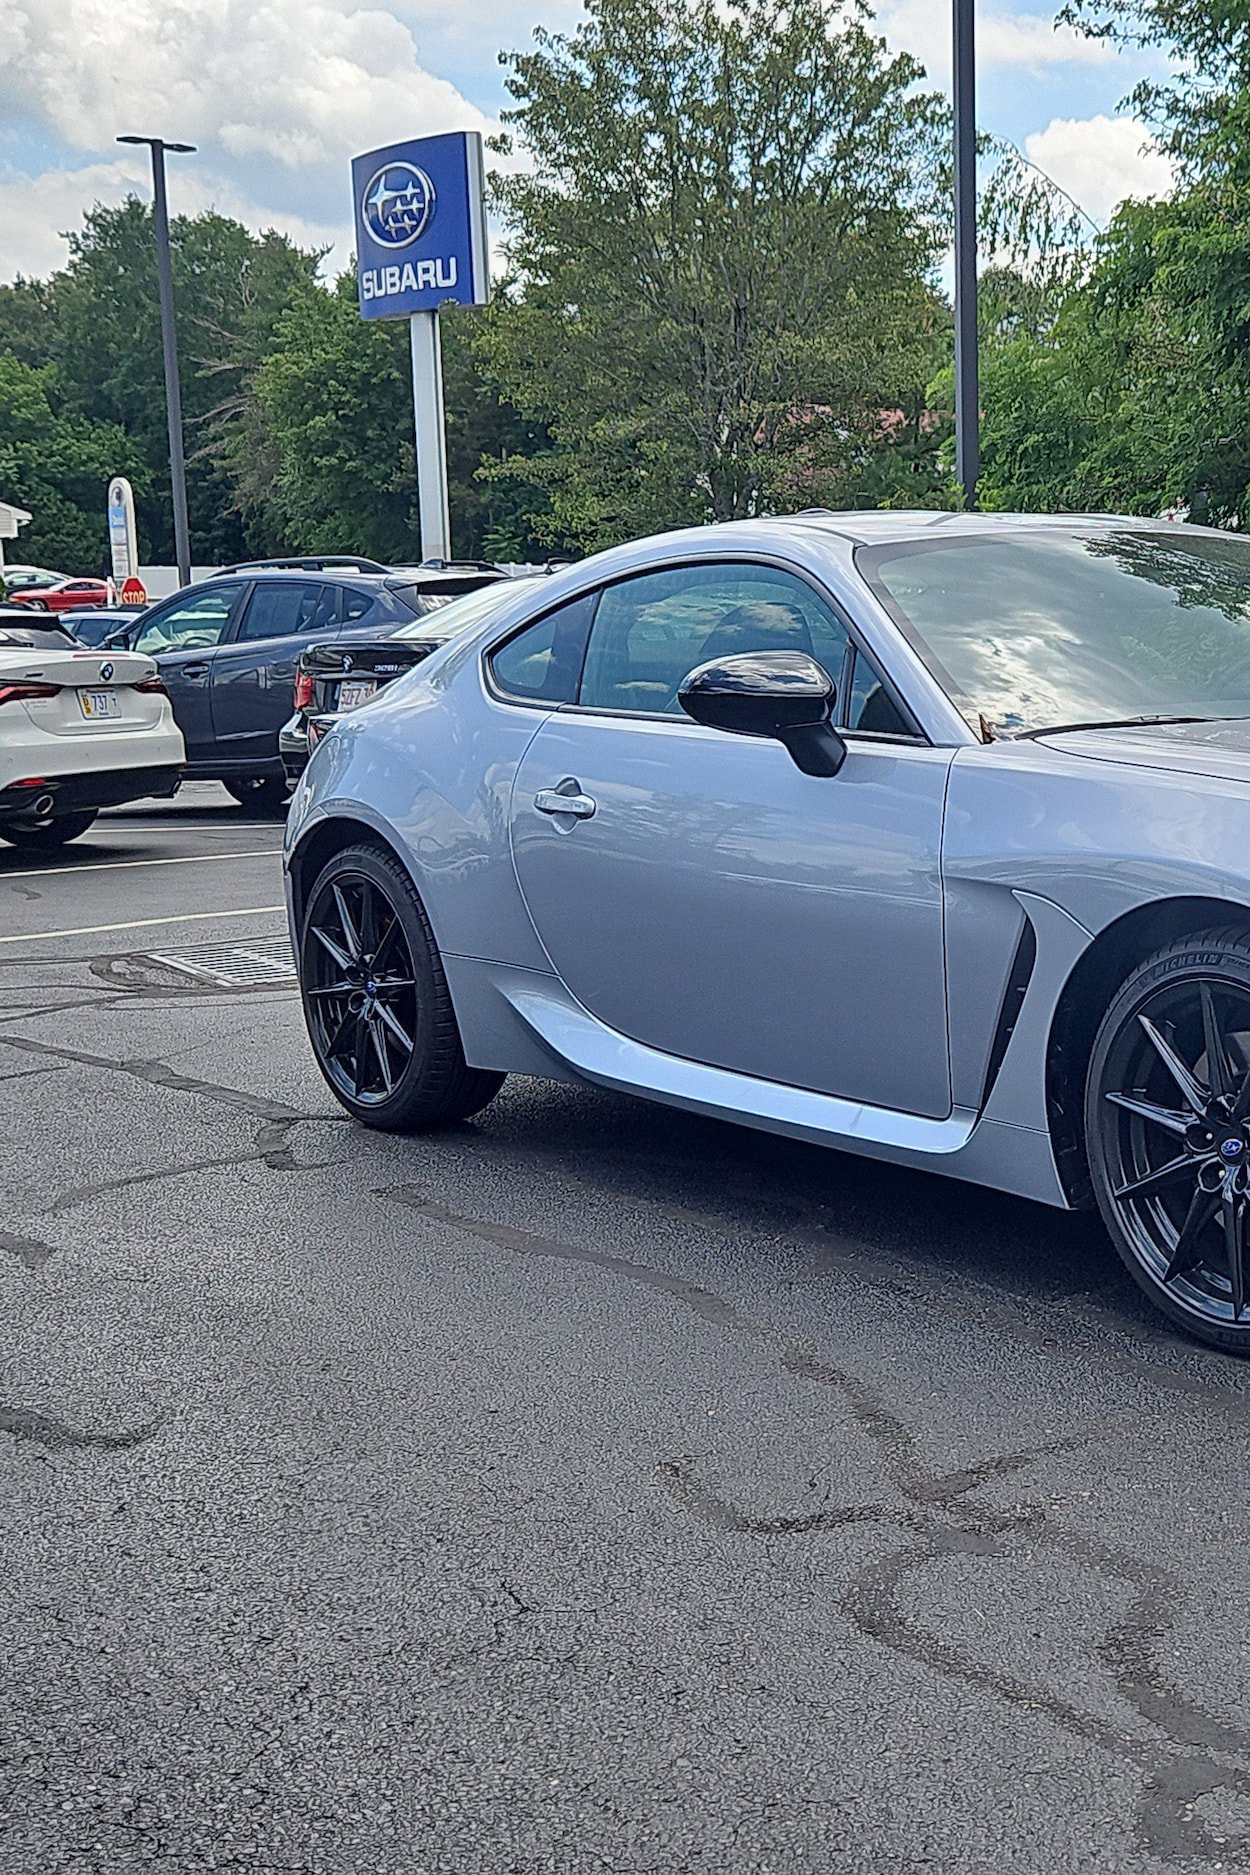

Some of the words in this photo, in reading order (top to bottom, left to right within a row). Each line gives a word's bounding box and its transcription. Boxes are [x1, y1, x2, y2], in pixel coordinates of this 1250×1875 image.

[362, 256, 457, 300] SUBARU
[123, 590, 145, 604] STOP
[91, 695, 107, 711] 737
[1154, 952, 1219, 977] MICHELIN
